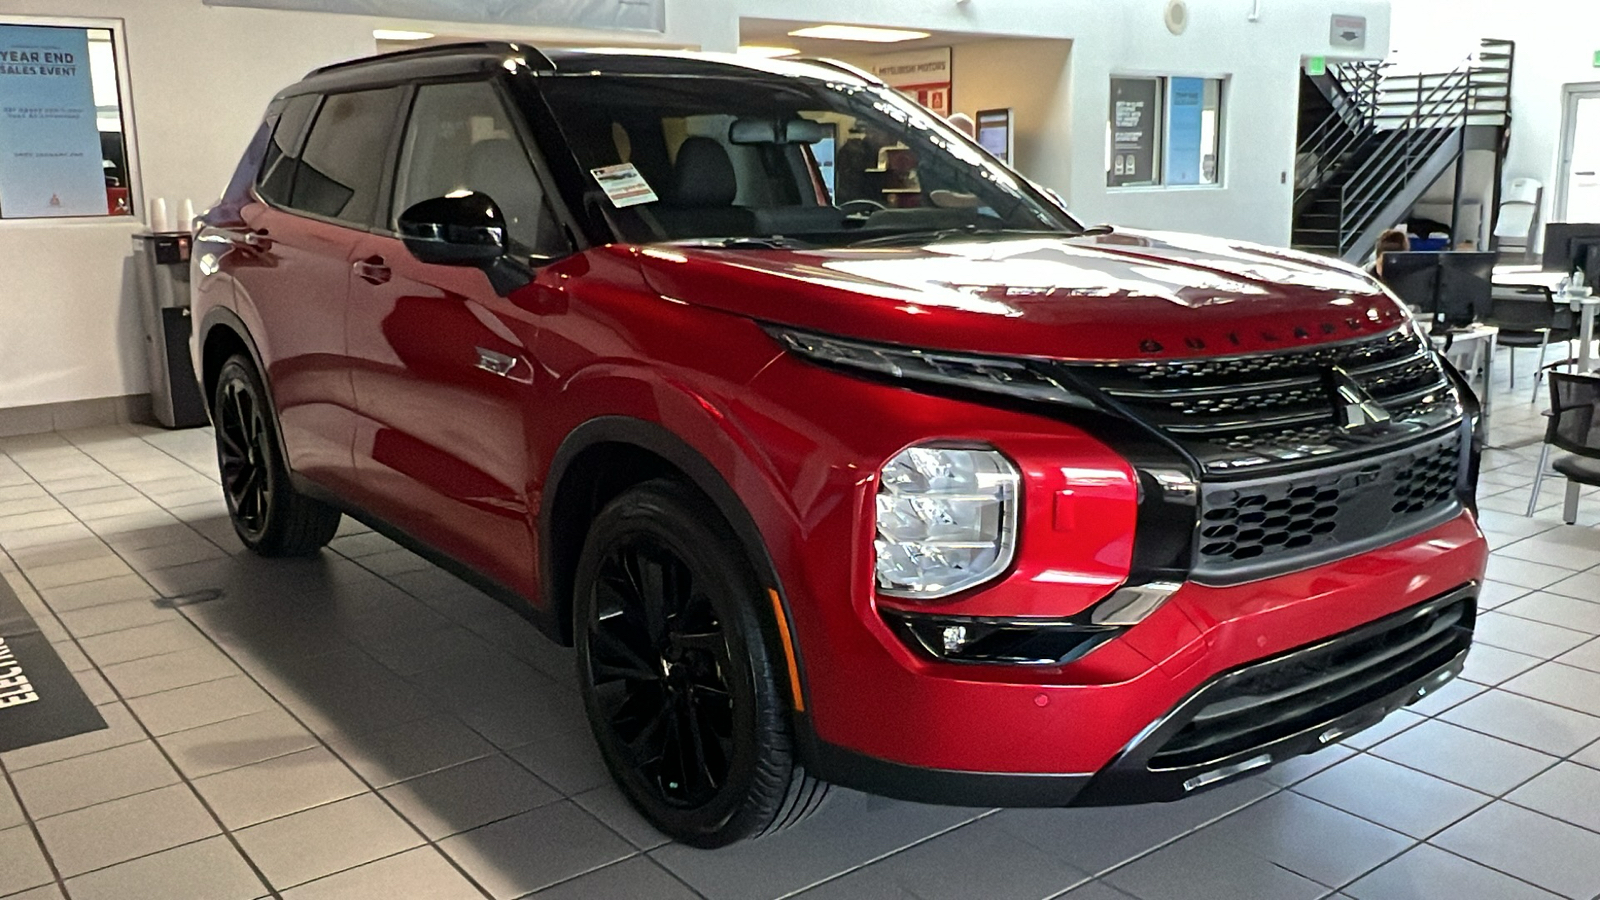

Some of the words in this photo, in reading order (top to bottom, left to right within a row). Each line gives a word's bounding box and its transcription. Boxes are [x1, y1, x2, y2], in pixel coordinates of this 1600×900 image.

[0, 51, 39, 62] YEAR
[44, 52, 74, 64] END
[0, 65, 36, 75] SALES
[40, 67, 76, 76] EVENT
[917, 62, 946, 72] MOTORS
